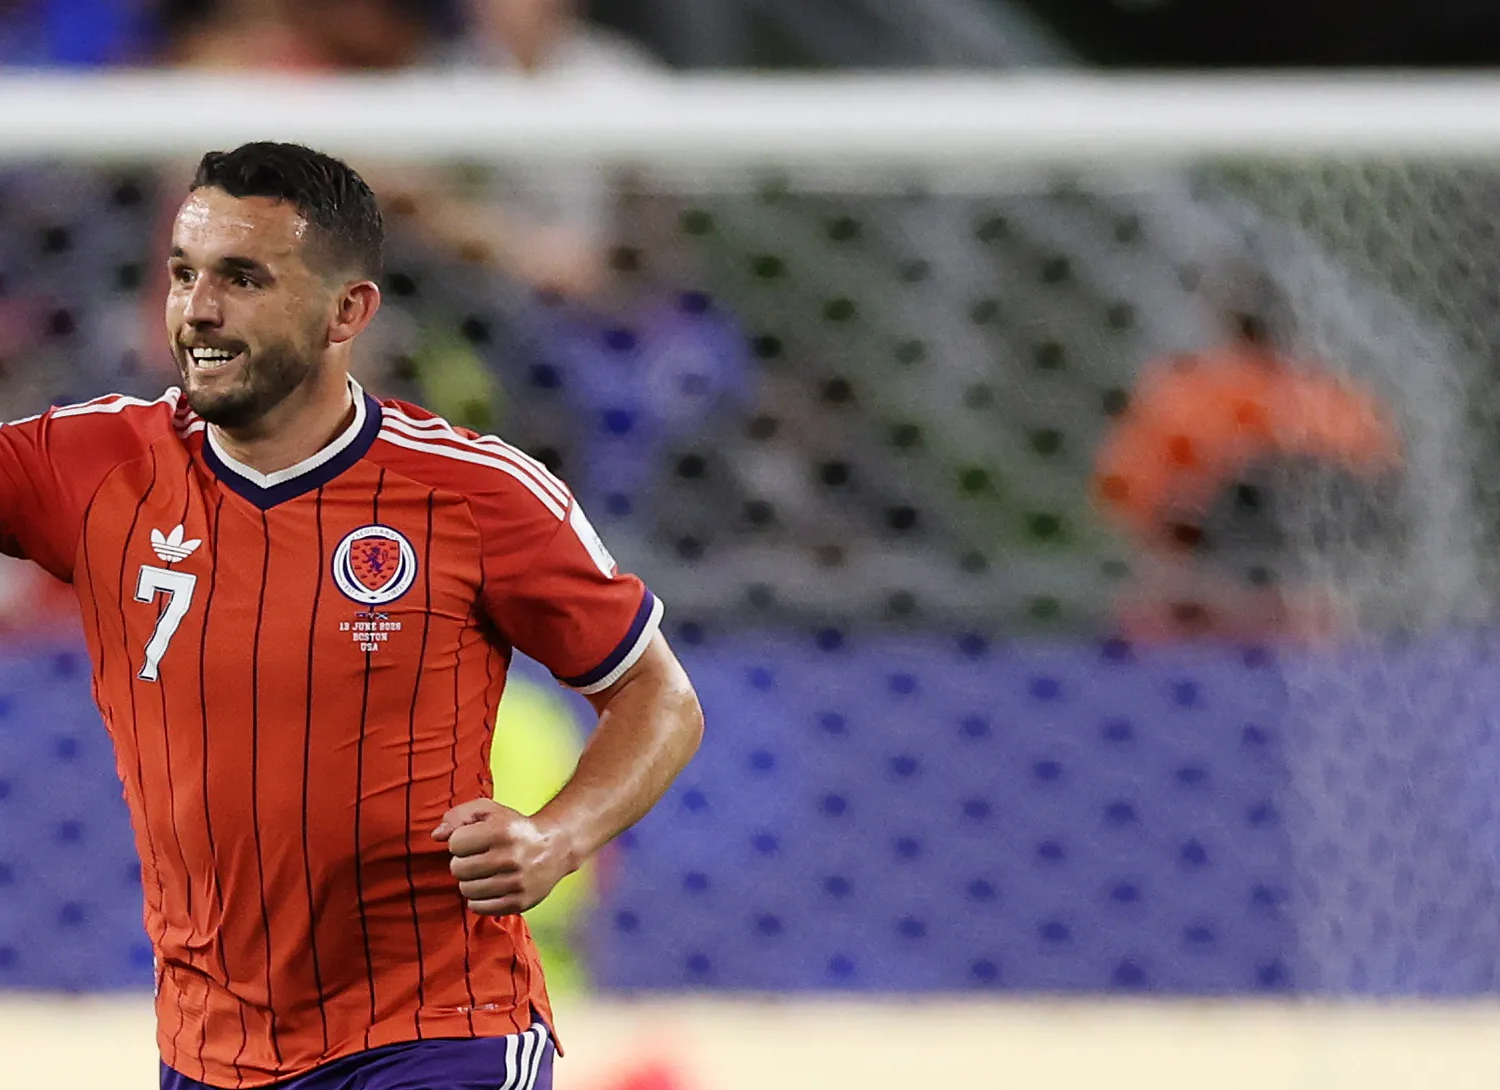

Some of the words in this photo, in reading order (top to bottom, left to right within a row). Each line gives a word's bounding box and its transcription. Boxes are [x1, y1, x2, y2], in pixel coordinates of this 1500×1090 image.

[355, 528, 395, 538] SCOTLAND
[134, 564, 198, 683] 7
[351, 622, 377, 631] JUNE
[352, 632, 388, 641] BOSTON
[360, 642, 379, 652] USA
